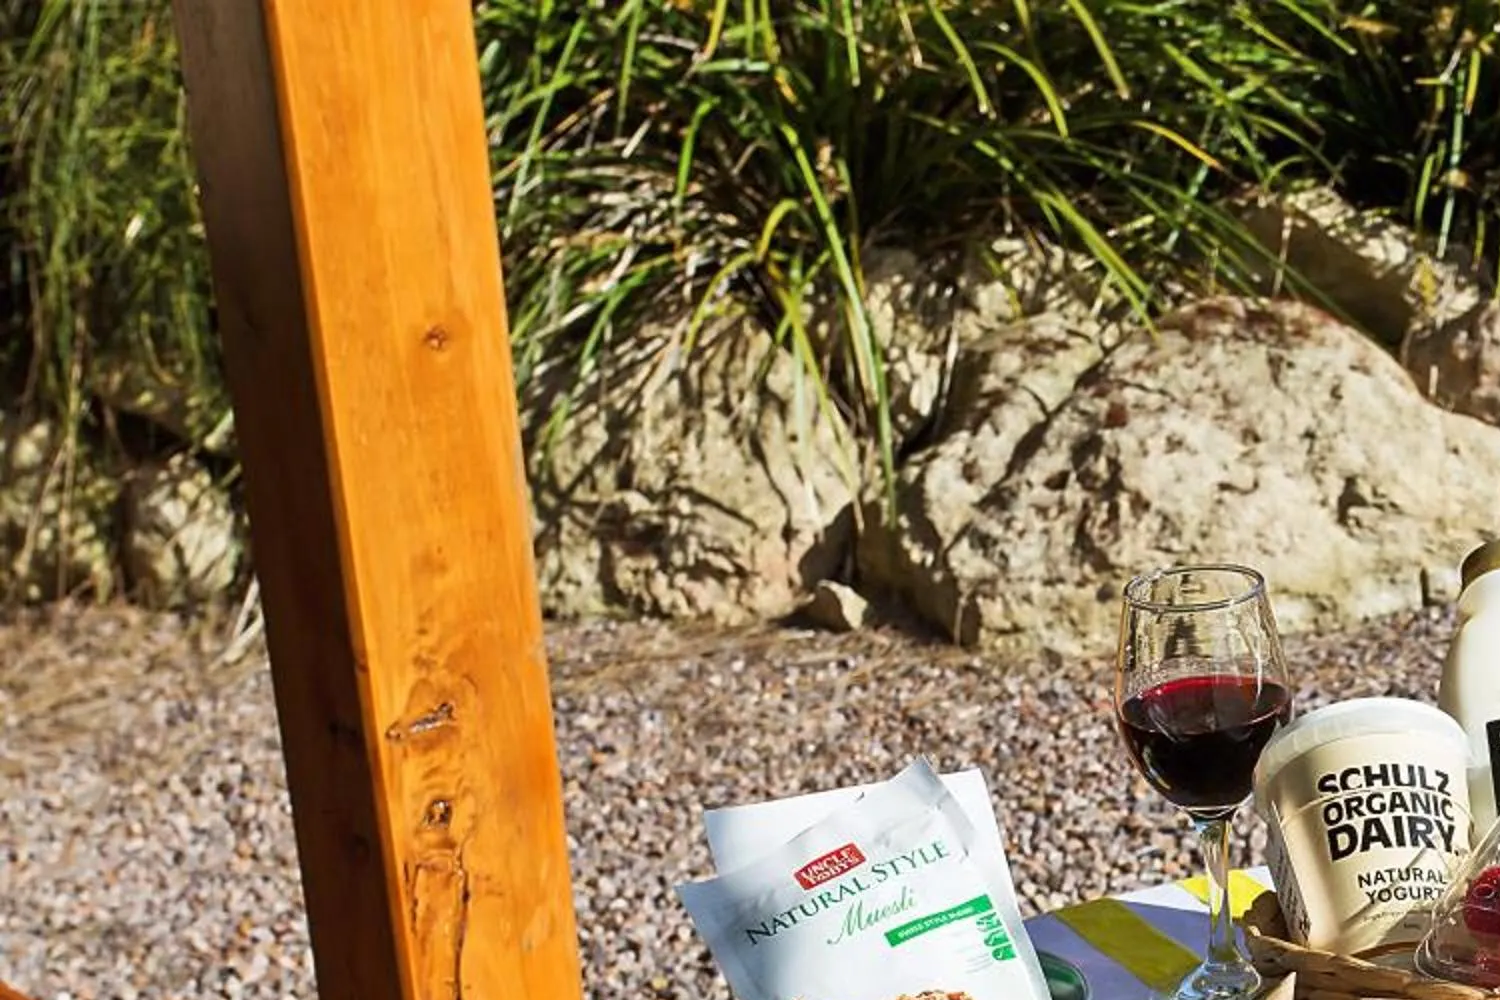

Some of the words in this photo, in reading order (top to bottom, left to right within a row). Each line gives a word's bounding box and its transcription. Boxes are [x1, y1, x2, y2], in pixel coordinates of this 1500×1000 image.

[1317, 763, 1452, 796] SCHULZ
[1322, 790, 1455, 826] ORGANIC
[745, 877, 870, 946] NATURAL
[872, 839, 951, 883] STYLE
[1358, 867, 1448, 887] NATURAL
[1365, 883, 1445, 905] YOGURT
[827, 886, 917, 944] Muesli
